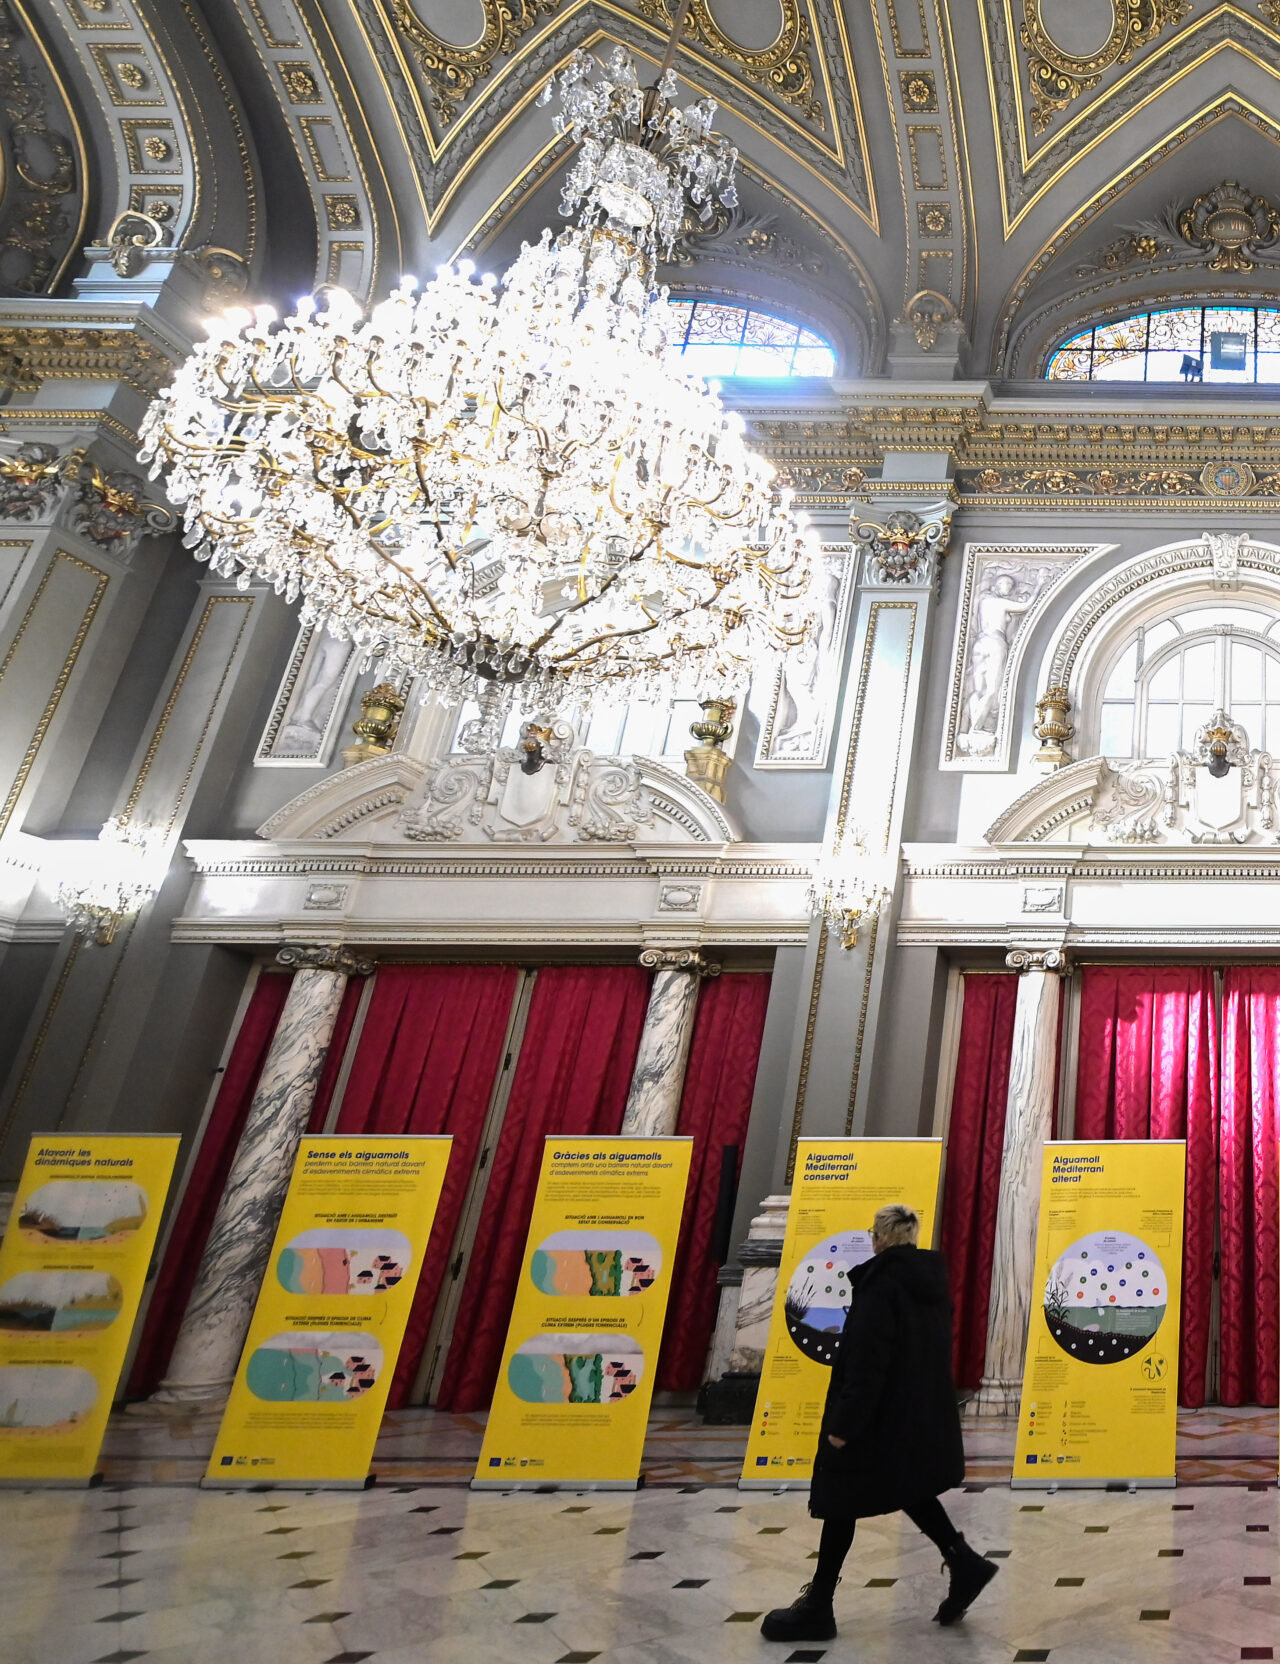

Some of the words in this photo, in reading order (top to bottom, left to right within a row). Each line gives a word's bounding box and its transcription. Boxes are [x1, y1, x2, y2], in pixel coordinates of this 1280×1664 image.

[37, 1148, 75, 1157] Afavorir
[78, 1148, 91, 1157] les
[307, 1151, 336, 1159] Sense
[339, 1150, 352, 1159] els
[355, 1150, 410, 1161] aiguamolls
[553, 1151, 590, 1160] Gràcies
[592, 1151, 607, 1160] als
[609, 1151, 662, 1162] aiguamolls
[94, 1158, 133, 1166] naturals
[806, 1153, 854, 1162] Aiguamoll
[1053, 1156, 1100, 1165] Aiguamoll
[805, 1163, 857, 1171] Mediterrani
[1052, 1165, 1104, 1174] Mediterrani
[803, 1173, 849, 1181] conservat
[1051, 1175, 1082, 1183] alterat
